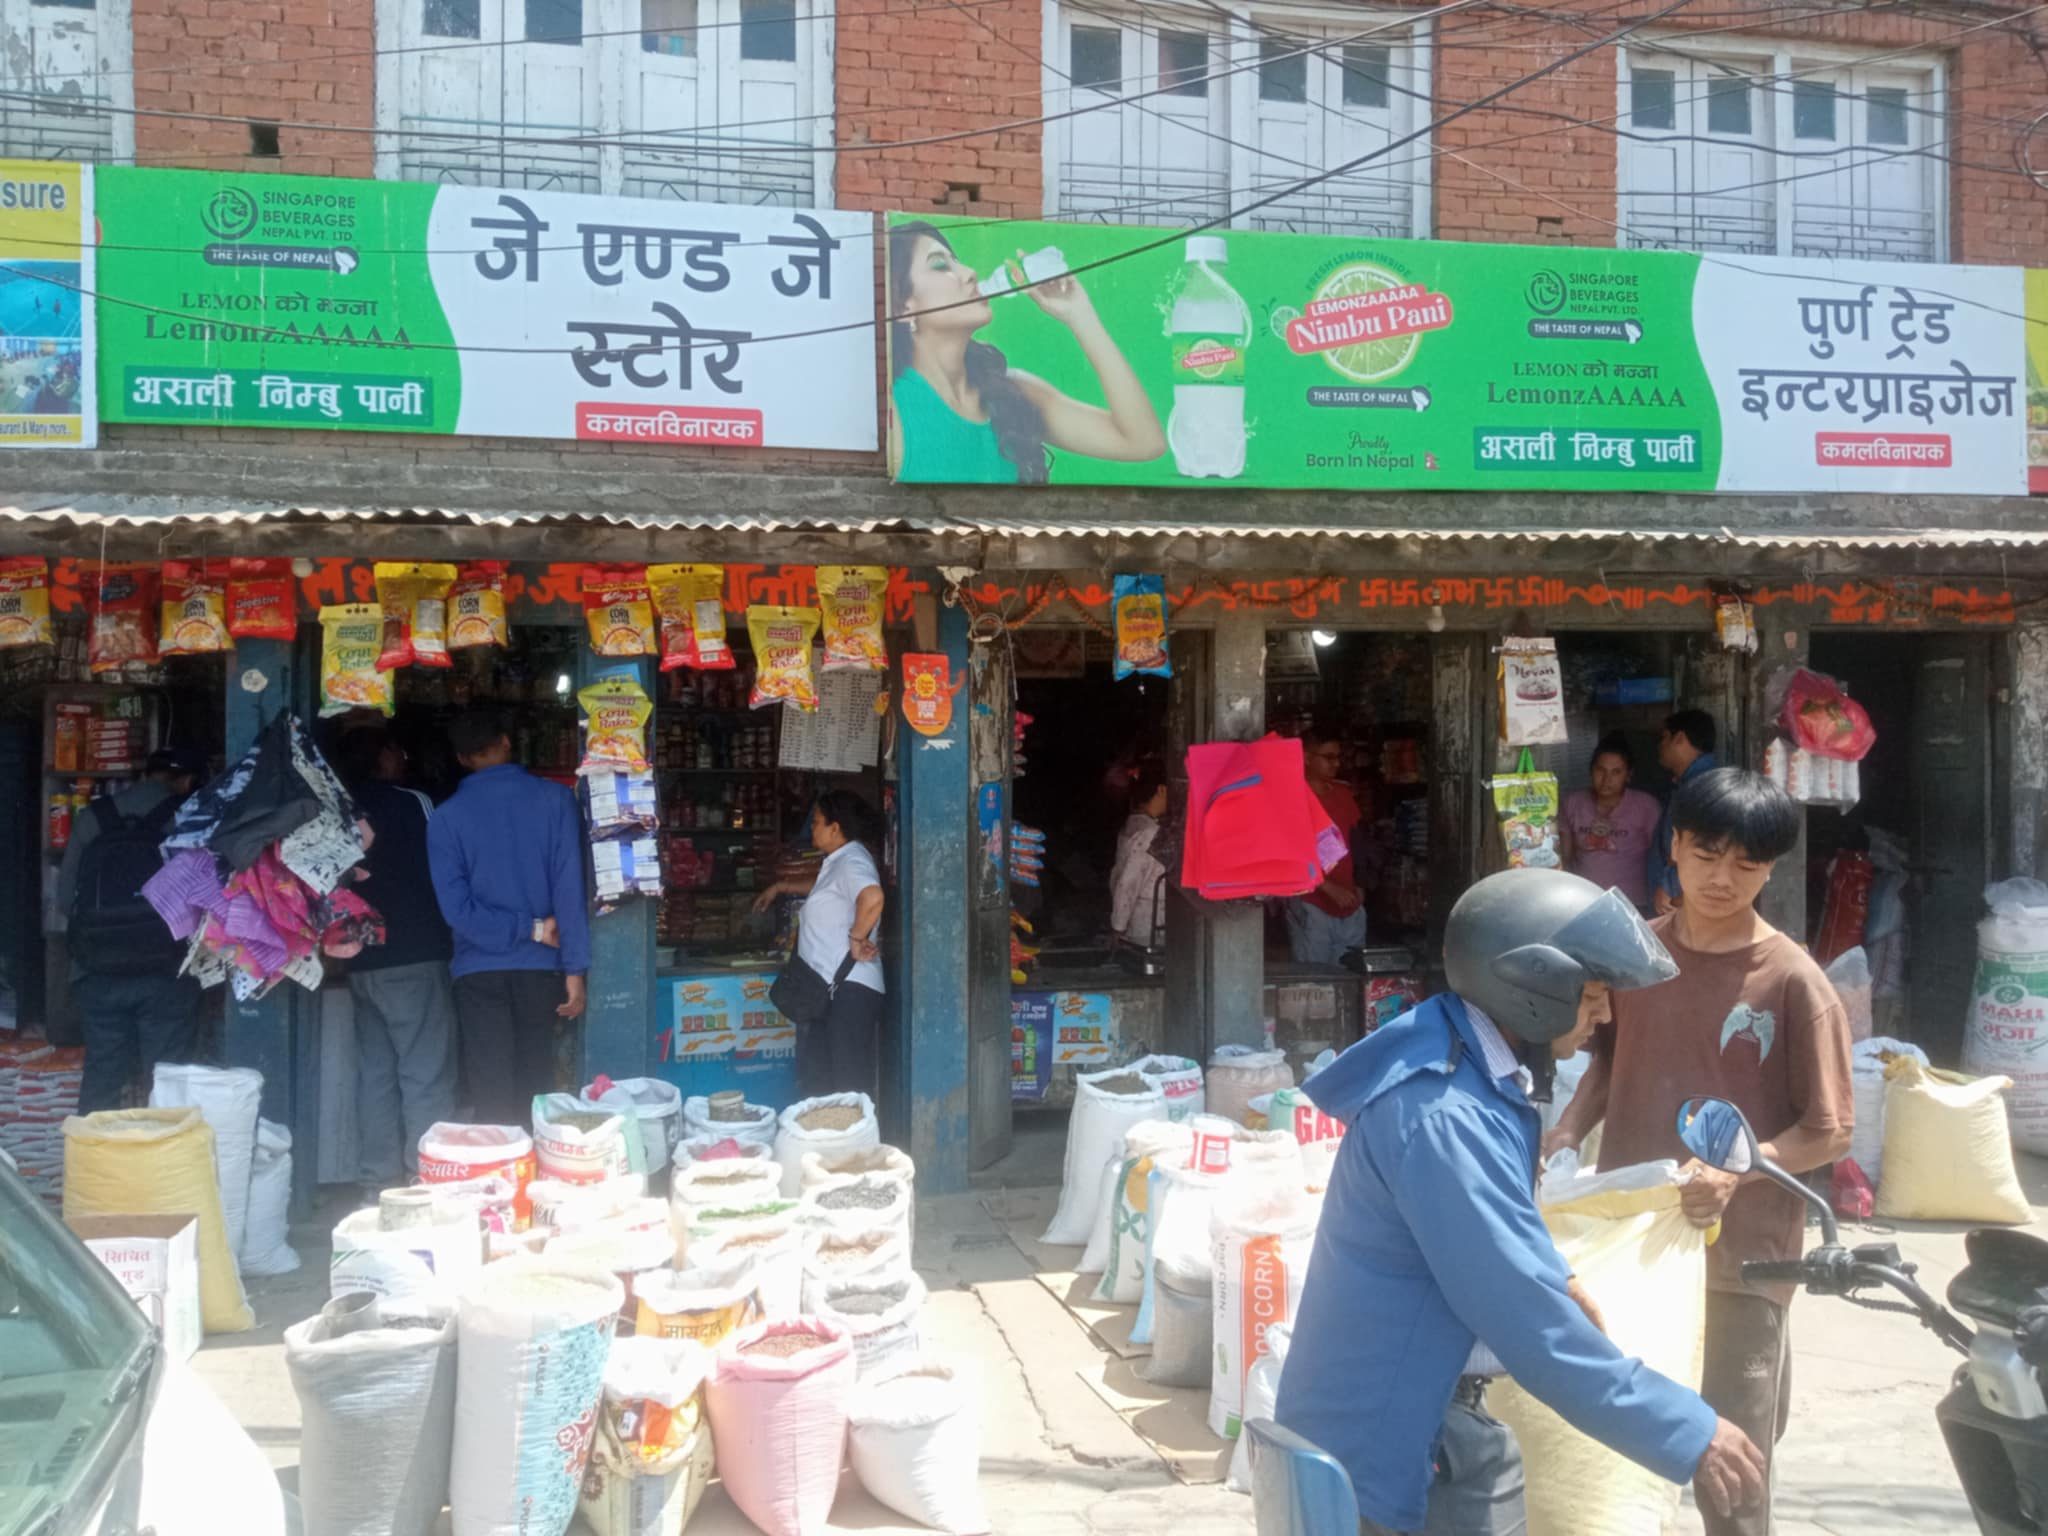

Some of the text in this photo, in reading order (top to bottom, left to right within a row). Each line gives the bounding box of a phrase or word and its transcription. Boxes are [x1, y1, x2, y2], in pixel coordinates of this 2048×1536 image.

[3, 181, 65, 210] sure
[262, 191, 356, 210] SINGAPORE
[262, 210, 356, 228] BEVERAGES
[261, 226, 300, 239] NEPAL
[211, 247, 331, 265] THE TASTE OF NEPAL
[470, 195, 840, 300] जे एण्ड जे
[1333, 251, 1374, 265] LEMON
[1569, 273, 1639, 287] SINGAPORE
[181, 292, 268, 312] LEMON
[275, 291, 311, 314] को
[1569, 289, 1639, 303] BEVERAGES
[1570, 304, 1598, 315] NEPAL
[1295, 298, 1447, 347] Nimbu Pani
[1534, 324, 1622, 336] THE TASTE OF NEPAL
[1798, 285, 1955, 360] पुर्ण ट्रेड
[567, 301, 752, 394] स्टोर
[1513, 362, 1577, 377] LEMON
[1583, 360, 1608, 380] को
[133, 373, 424, 417] असली निम्बु पानी
[1313, 391, 1408, 403] THE TASTE OF NEPAL
[1487, 382, 1687, 408] LemonzAAAAA
[1738, 359, 2017, 425] इन्टरप्राइजेज
[586, 410, 755, 440] कमलविनायक
[1480, 431, 1696, 467] असली निम्बु पानी
[1821, 438, 1946, 461] कमलविनायक
[1306, 453, 1344, 468] Born
[1367, 453, 1414, 472] Nepal
[236, 596, 280, 608] Digestive
[836, 605, 867, 617] Corn
[610, 606, 630, 618] CORN
[838, 616, 872, 628] Flakes
[768, 646, 800, 659] Corn
[597, 708, 632, 719] Corn
[1980, 1001, 2045, 1020] MAHI
[1254, 1250, 1273, 1315] CORN
